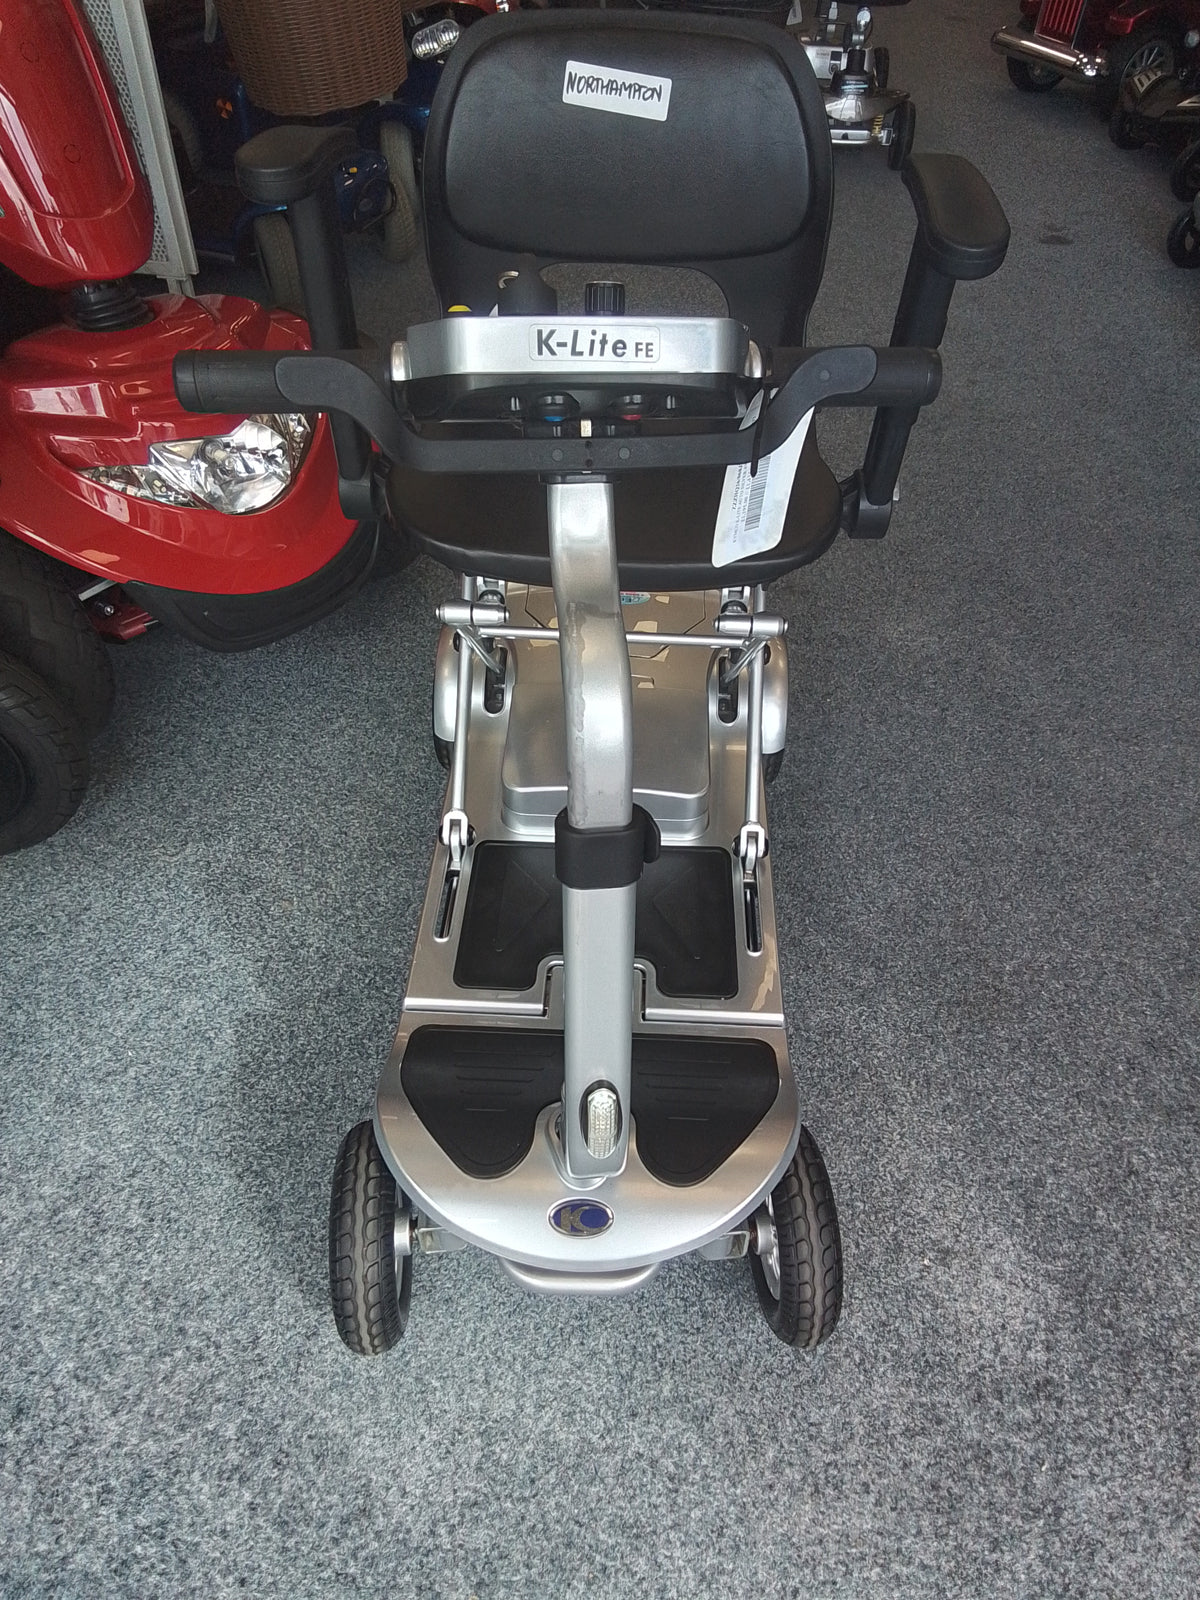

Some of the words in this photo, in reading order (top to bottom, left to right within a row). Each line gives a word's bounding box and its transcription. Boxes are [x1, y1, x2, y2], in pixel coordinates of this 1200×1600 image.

[566, 71, 663, 102] NORTHAMPTON
[536, 328, 628, 358] K-Lite
[634, 341, 654, 358] FE
